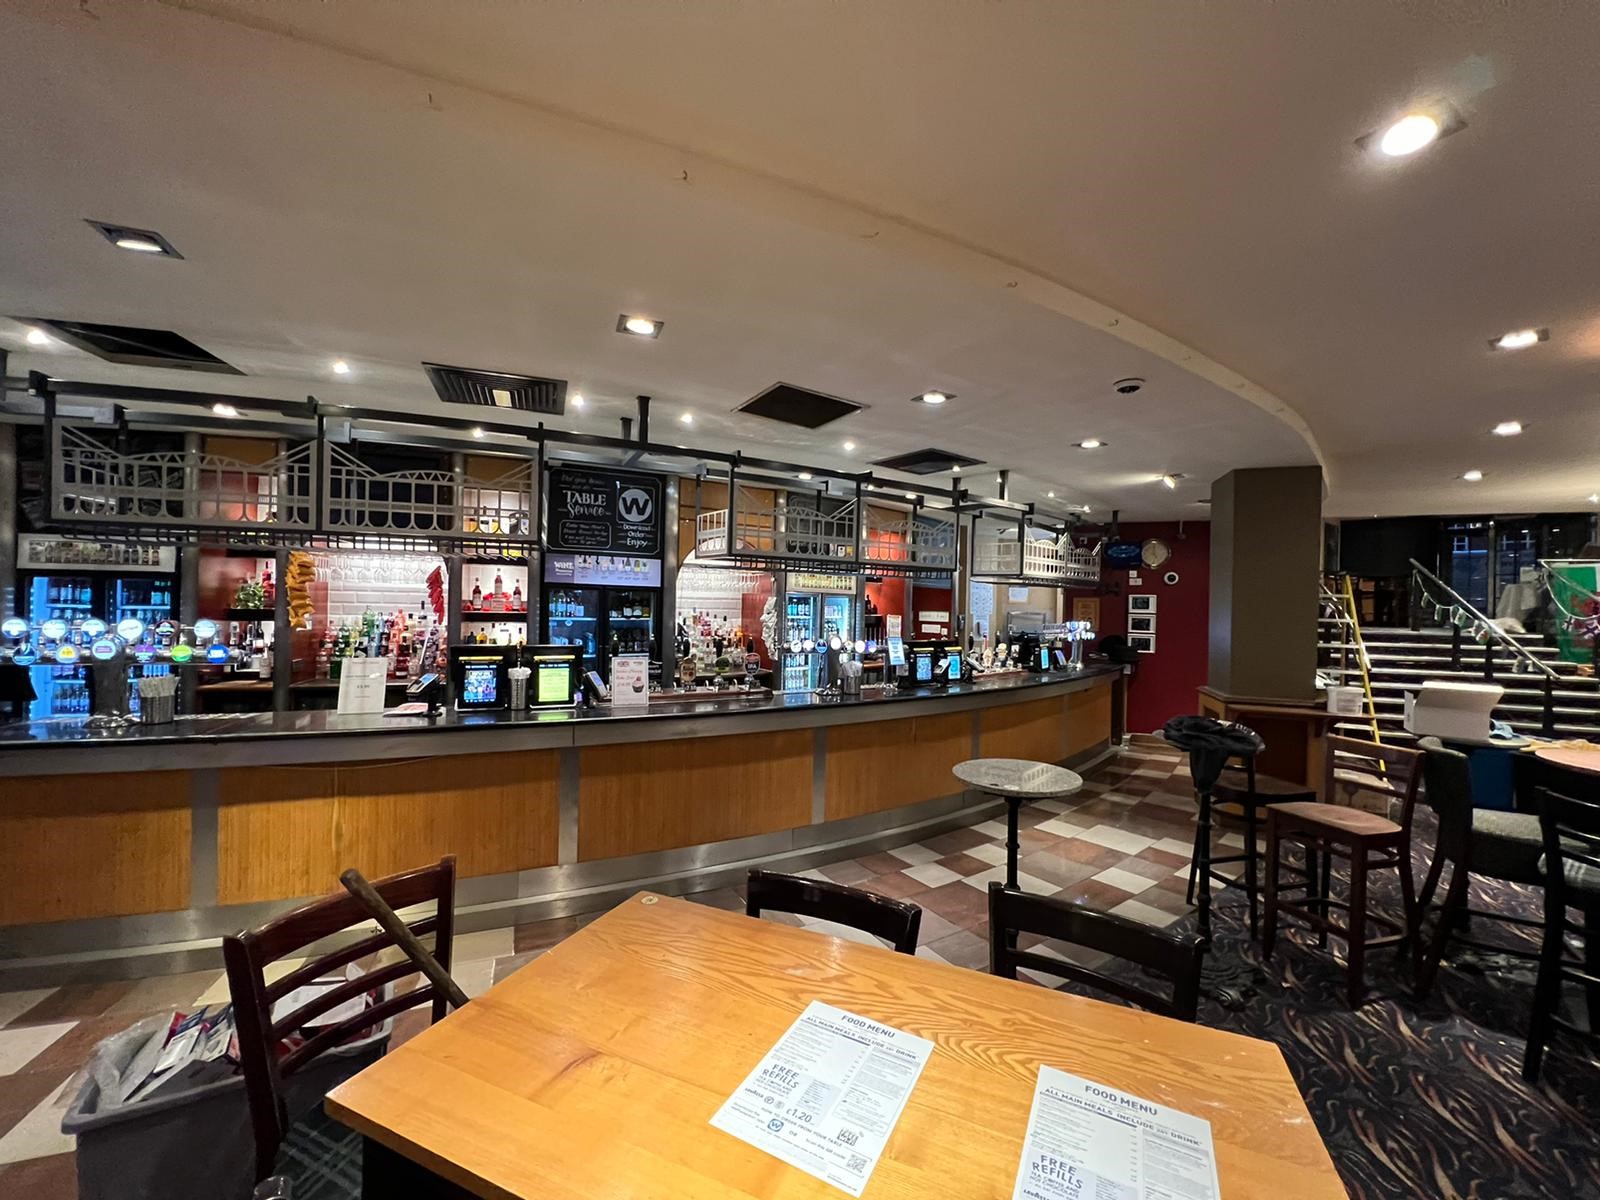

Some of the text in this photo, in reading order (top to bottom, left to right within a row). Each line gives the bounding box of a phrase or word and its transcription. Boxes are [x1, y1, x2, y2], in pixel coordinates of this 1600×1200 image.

[562, 490, 607, 506] TABLE
[621, 496, 650, 516] W
[567, 502, 605, 519] Service
[623, 524, 651, 532] Download
[626, 538, 649, 549] Enjoy
[818, 1021, 835, 1030] MAIN
[834, 1025, 857, 1037] MEALS
[857, 1035, 885, 1048] INCLUDE
[841, 1014, 896, 1039] FOOD MENU
[761, 1068, 800, 1089] REFILLS
[772, 1063, 800, 1080] FREE
[1044, 1088, 1060, 1097] ALL
[1061, 1094, 1083, 1104] MAIN
[1084, 1101, 1114, 1115] MEALS
[1117, 1112, 1155, 1130] INCLUDE
[1084, 1084, 1158, 1116] FOOD MENU
[1031, 1161, 1084, 1189] REFILLS
[1040, 1154, 1078, 1176] FREE
